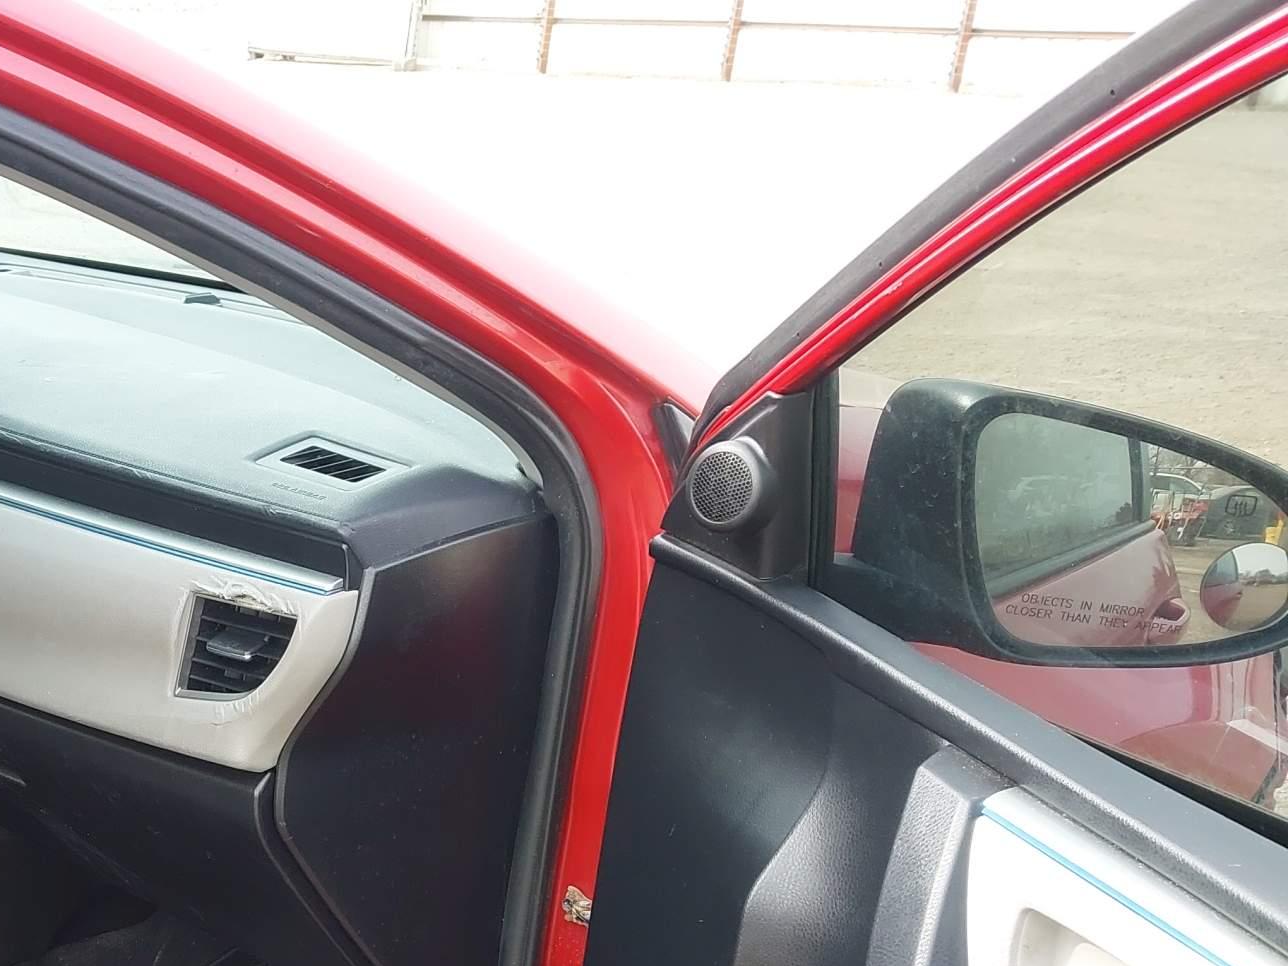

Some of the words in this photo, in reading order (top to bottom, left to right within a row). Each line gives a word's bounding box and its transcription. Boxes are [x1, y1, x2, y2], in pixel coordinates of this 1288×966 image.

[1005, 604, 1053, 619] CLOSER
[1061, 611, 1092, 624] THAN
[1099, 615, 1129, 629] THEY
[1134, 620, 1183, 634] APPEAR
[1021, 592, 1074, 609] OBJECTS
[1080, 600, 1093, 611] IN
[1099, 602, 1145, 618] MIRROR
